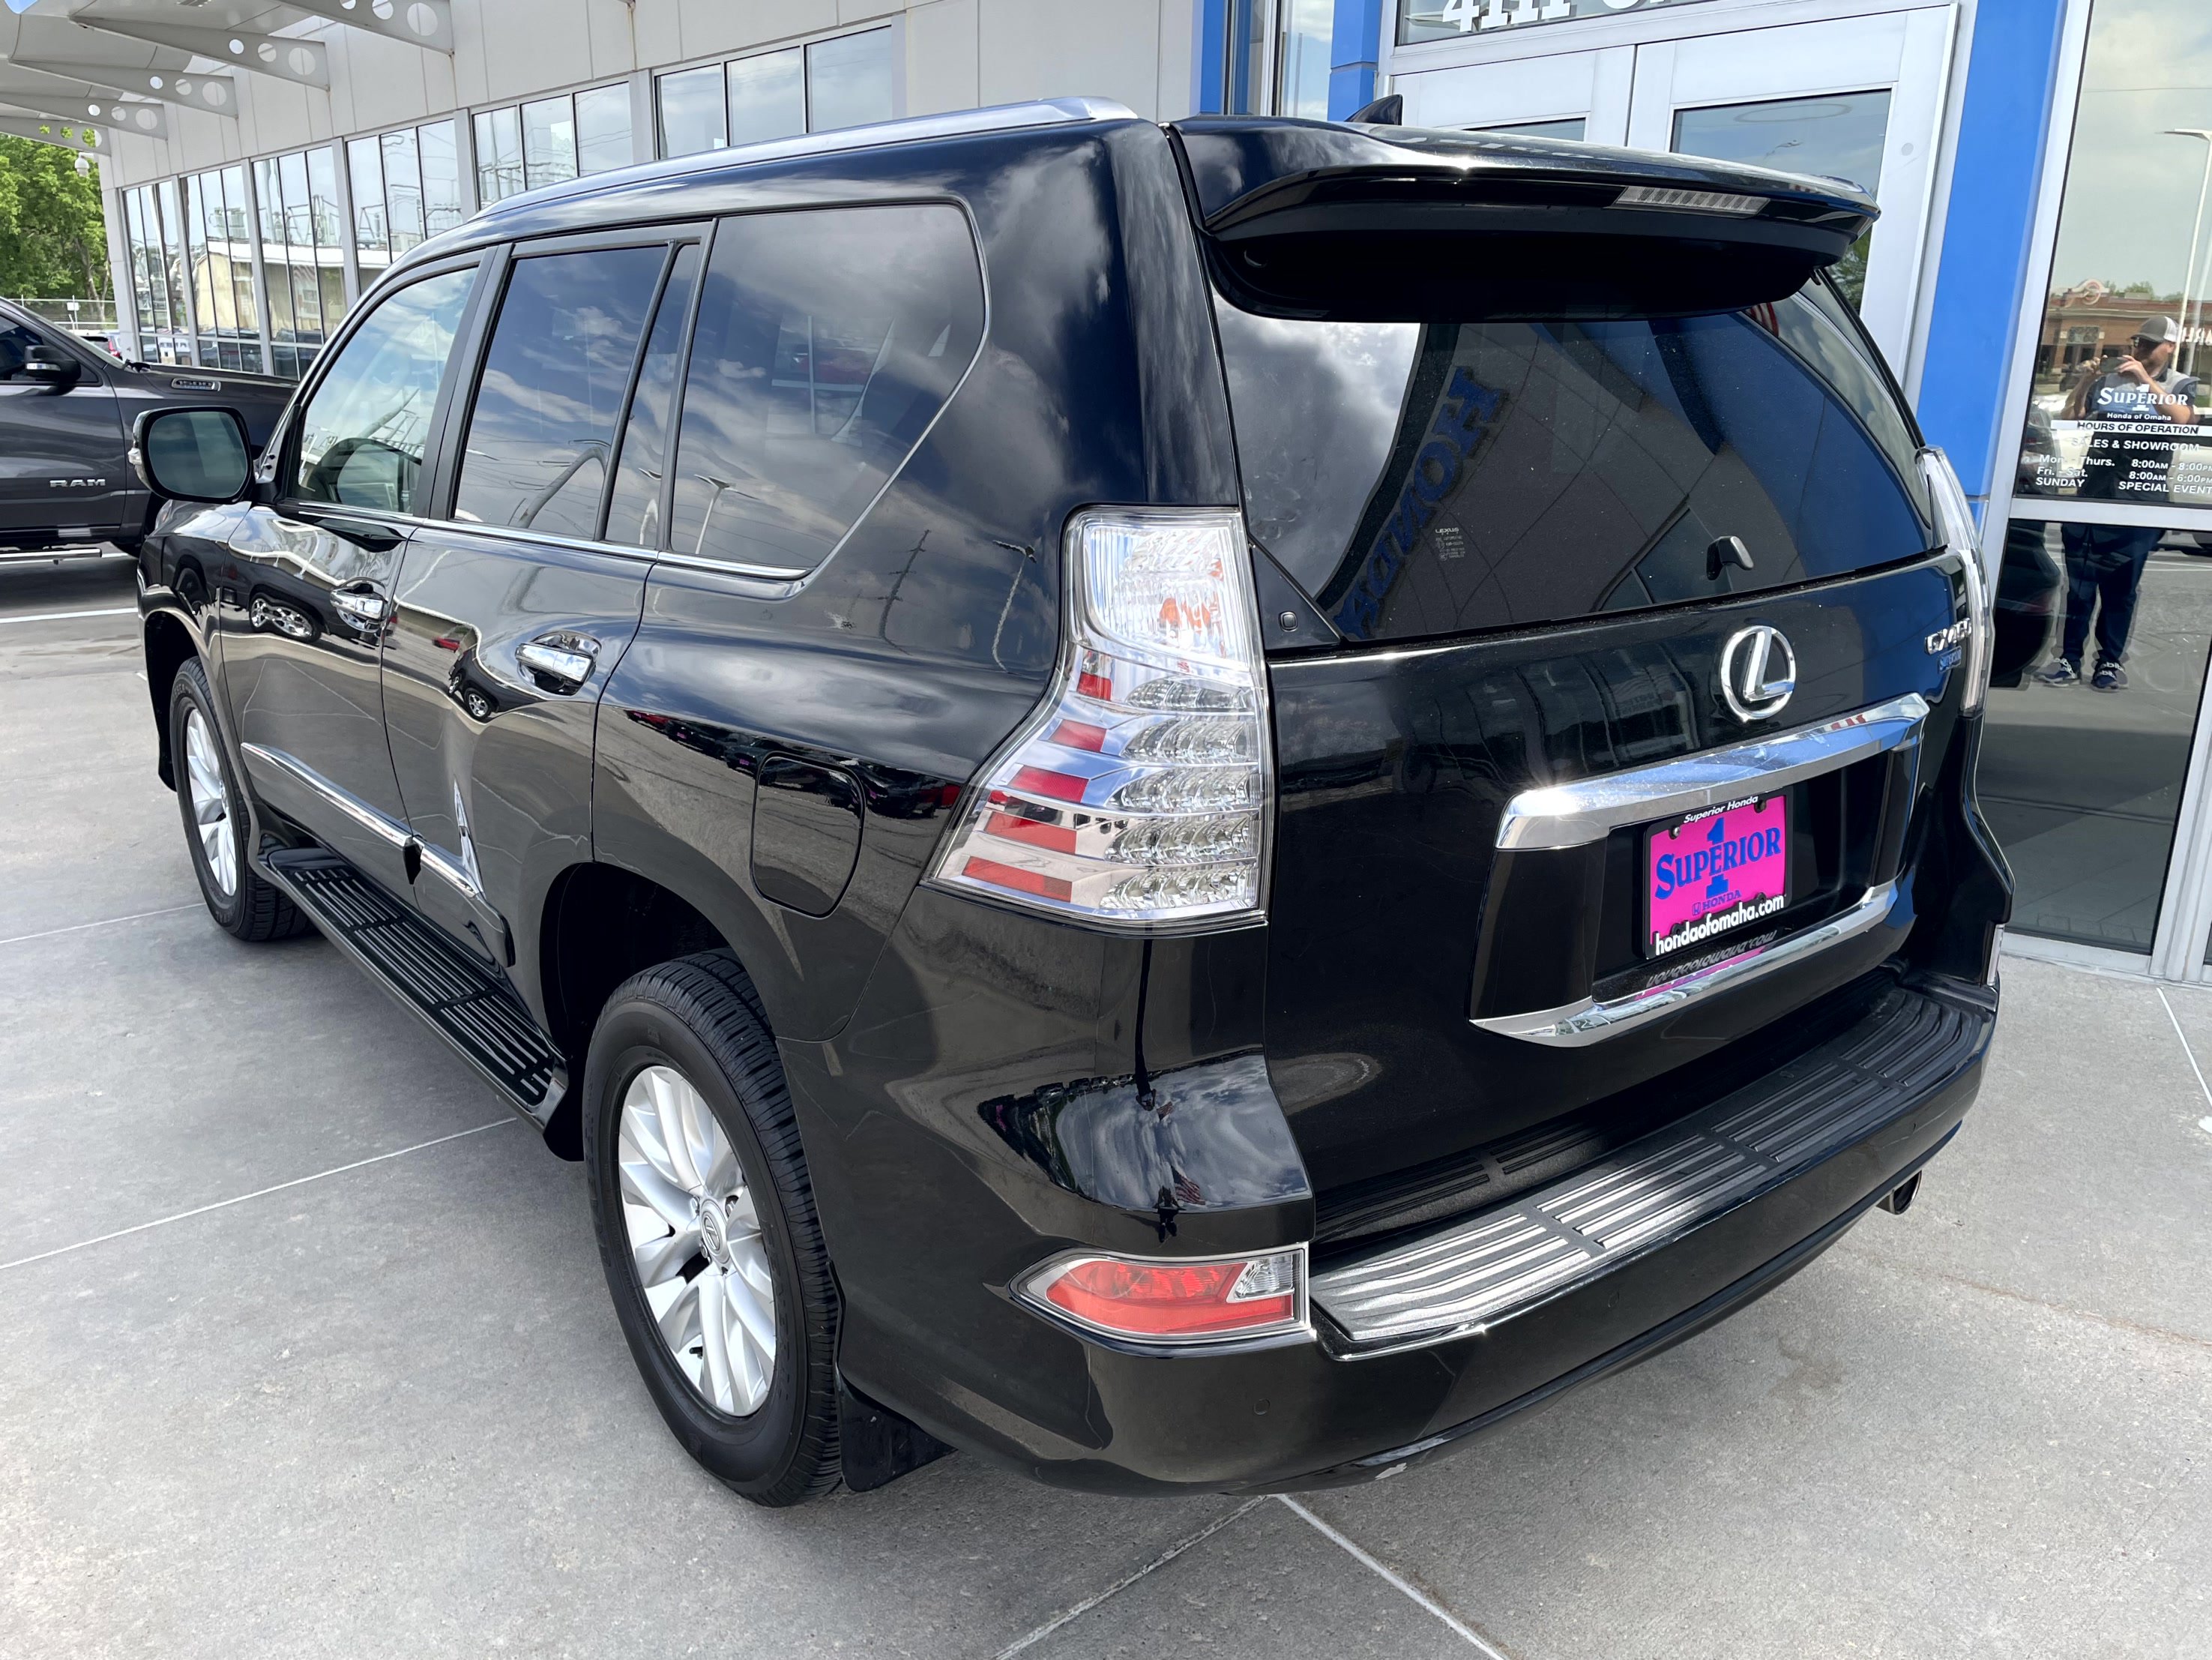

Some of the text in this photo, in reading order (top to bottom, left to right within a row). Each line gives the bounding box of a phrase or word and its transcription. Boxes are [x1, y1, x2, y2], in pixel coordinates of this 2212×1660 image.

[2097, 387, 2189, 406] SUPERIOR
[2077, 421, 2199, 435] HOURS OF OPERATION
[2071, 437, 2200, 451] SALES & SHOWROOM
[2081, 456, 2115, 466] Thurs.
[2037, 466, 2055, 475] Fri.
[2066, 467, 2088, 478] Sat.
[49, 478, 106, 488] RAM
[2035, 477, 2085, 487] SUNDAY
[2118, 481, 2169, 493] SPECIAL
[1684, 796, 1759, 823] Superior Honda
[1655, 827, 1782, 900] SUPERIOR
[1702, 889, 1742, 912] HONDA
[1655, 895, 1785, 956] hondaofomaha.com
